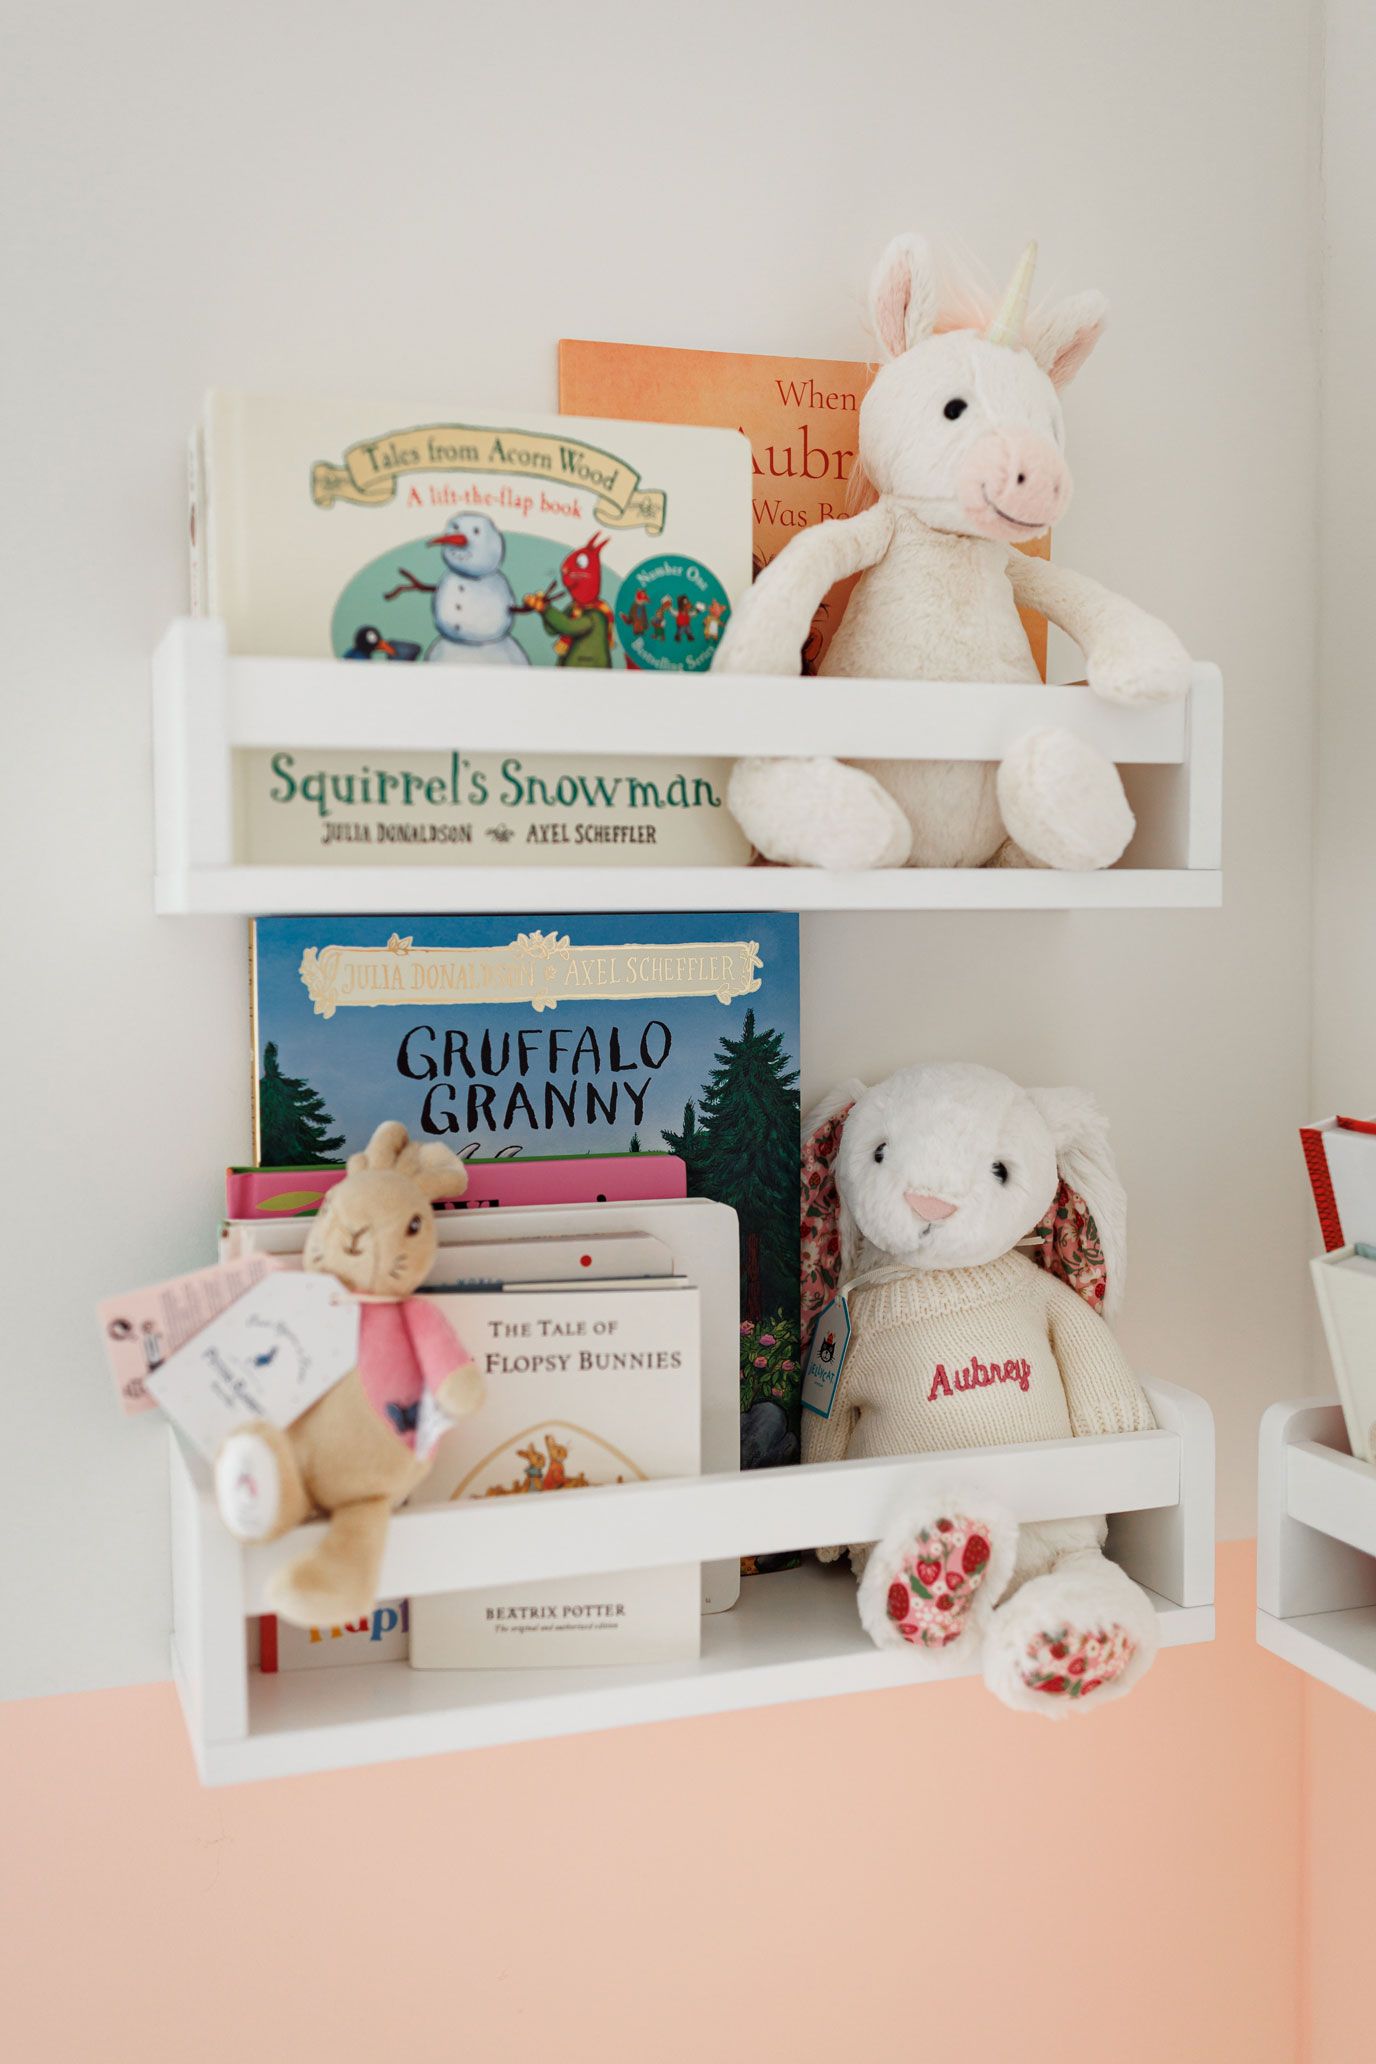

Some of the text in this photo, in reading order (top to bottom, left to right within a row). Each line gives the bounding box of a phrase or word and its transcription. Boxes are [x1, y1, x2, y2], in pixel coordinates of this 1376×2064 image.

[775, 378, 857, 411] When
[364, 435, 620, 493] Tales from Acorn Wood
[742, 424, 854, 480] ubr
[407, 484, 582, 518] A lift-the-flap book
[752, 498, 808, 528] Was
[635, 560, 683, 588] Number
[271, 750, 722, 816] Squirrel's Snowman
[321, 822, 657, 844] JULIA DONALDSON AXEL SCHEFFLER
[341, 961, 405, 993] JULIA
[564, 958, 622, 986] AXEL
[626, 954, 737, 984] SCHEFFLER
[397, 1020, 672, 1081] GRUFFALO
[420, 1076, 652, 1135] GRANNY
[488, 1319, 619, 1339] THE TALE OF
[485, 1350, 682, 1374] FLOPSY BUNNIES
[927, 1356, 1031, 1402] Aubrey
[485, 1603, 626, 1620] BEATRIX POTTER
